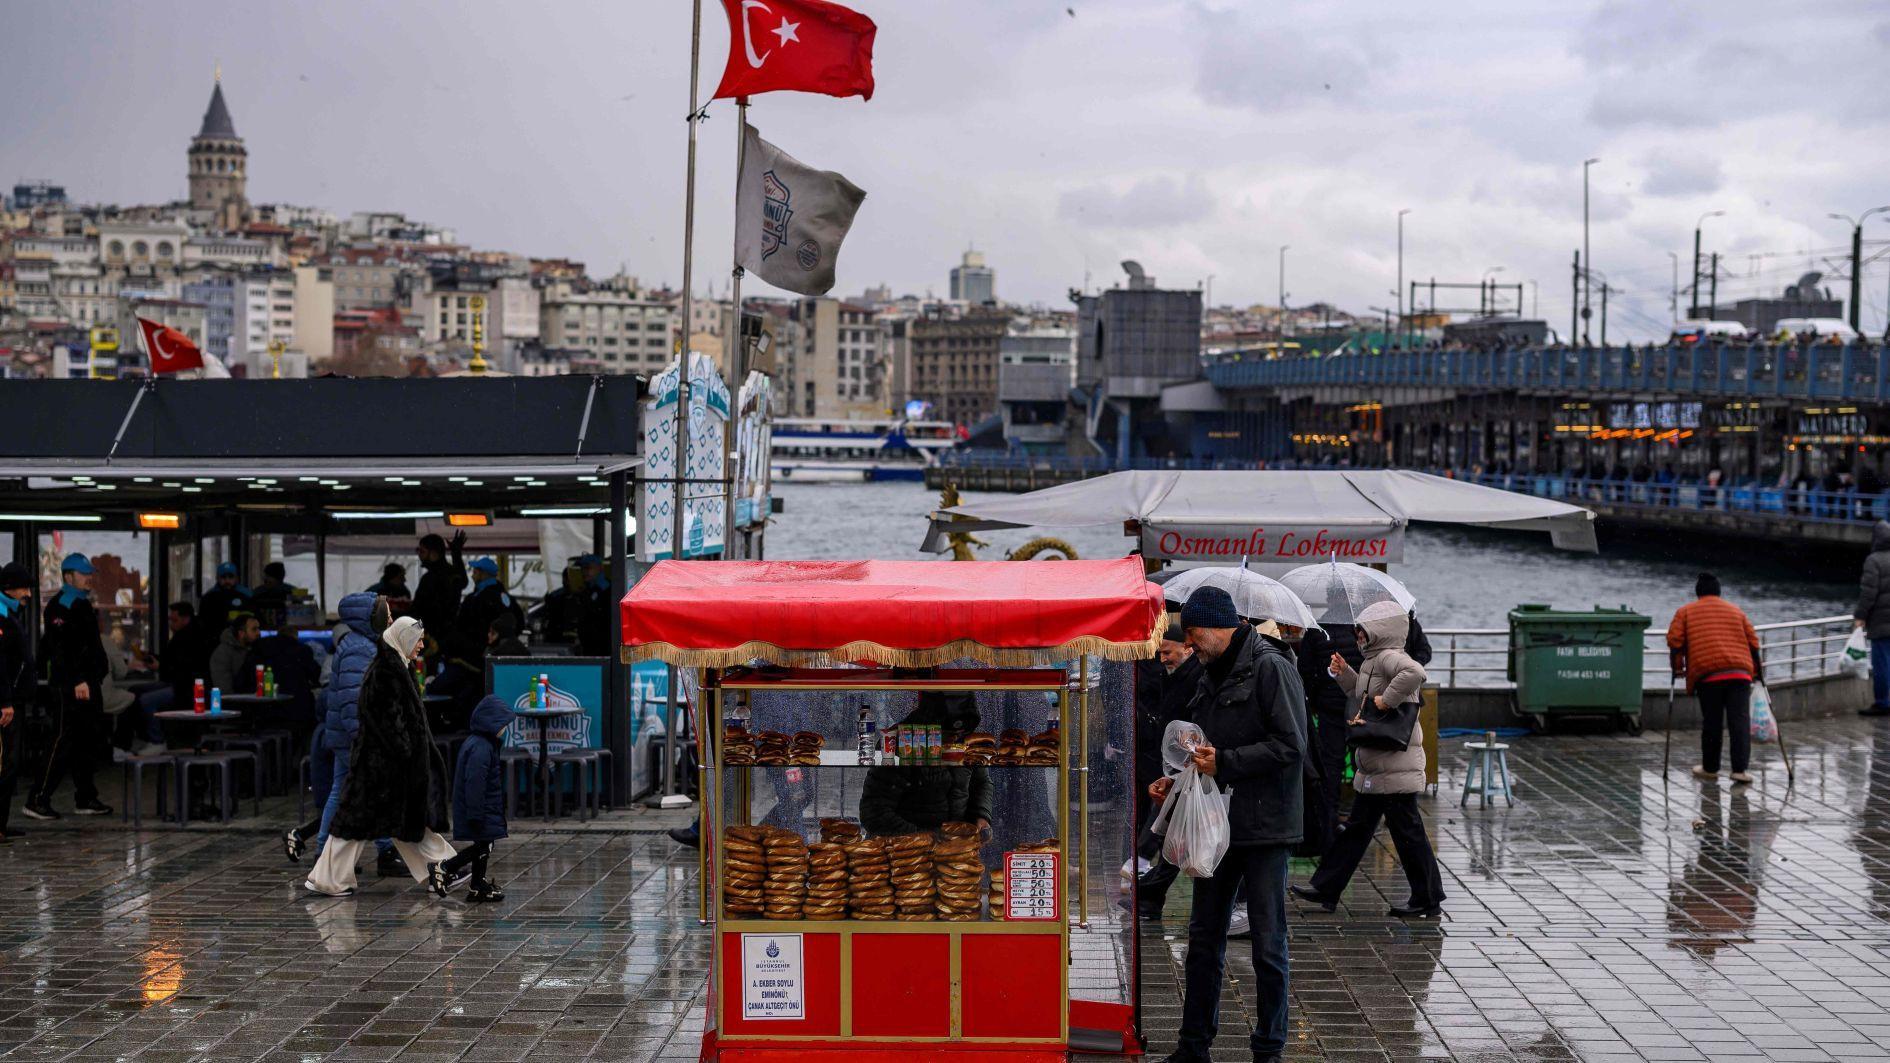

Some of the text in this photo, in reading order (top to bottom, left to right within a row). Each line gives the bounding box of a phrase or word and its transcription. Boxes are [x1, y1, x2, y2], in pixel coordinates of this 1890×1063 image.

[1158, 528, 1388, 557] Osmanlı Lokması
[1030, 860, 1045, 868] 20
[1031, 869, 1046, 878] 50
[1030, 879, 1045, 888] 50
[1030, 888, 1046, 897] 20
[1029, 898, 1045, 906] 20
[1030, 908, 1043, 916] 15
